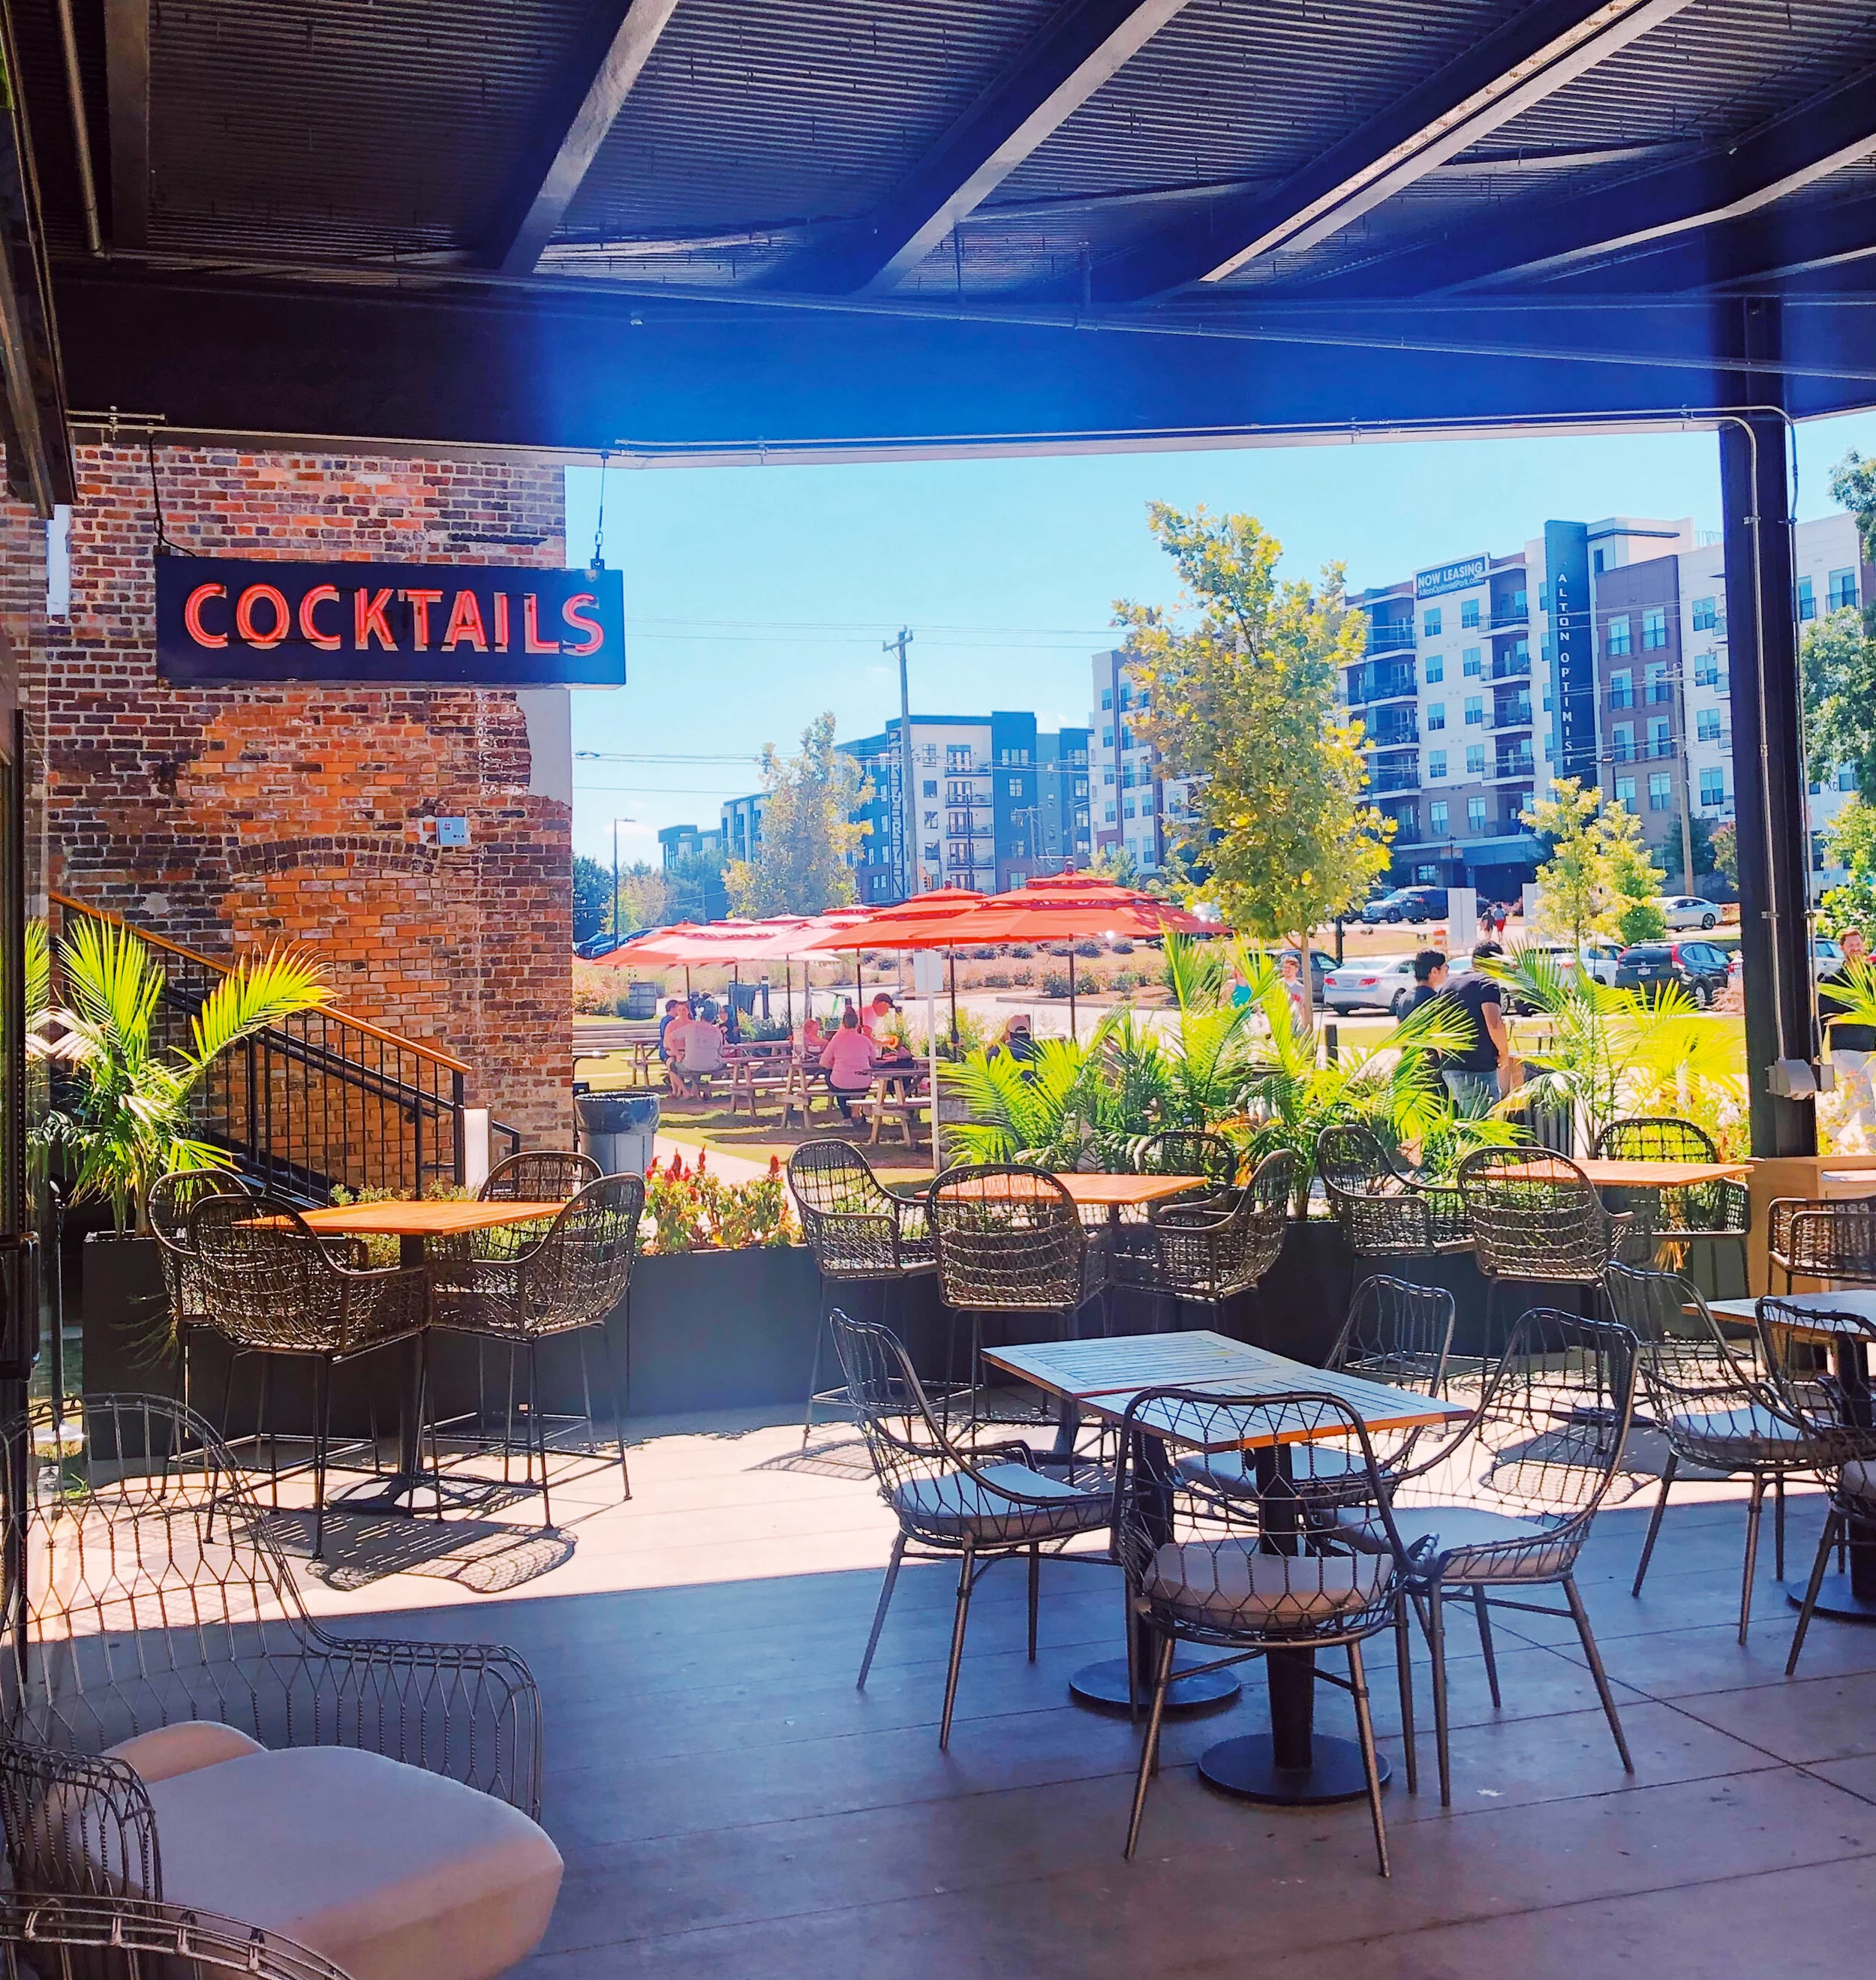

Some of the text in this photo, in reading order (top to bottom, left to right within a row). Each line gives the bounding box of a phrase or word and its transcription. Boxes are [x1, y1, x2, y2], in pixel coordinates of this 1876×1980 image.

[1418, 561, 1483, 589] NOW LEASING
[185, 583, 605, 656] COCKTAILS
[1558, 573, 1573, 766] ALTON OPTIMIST
